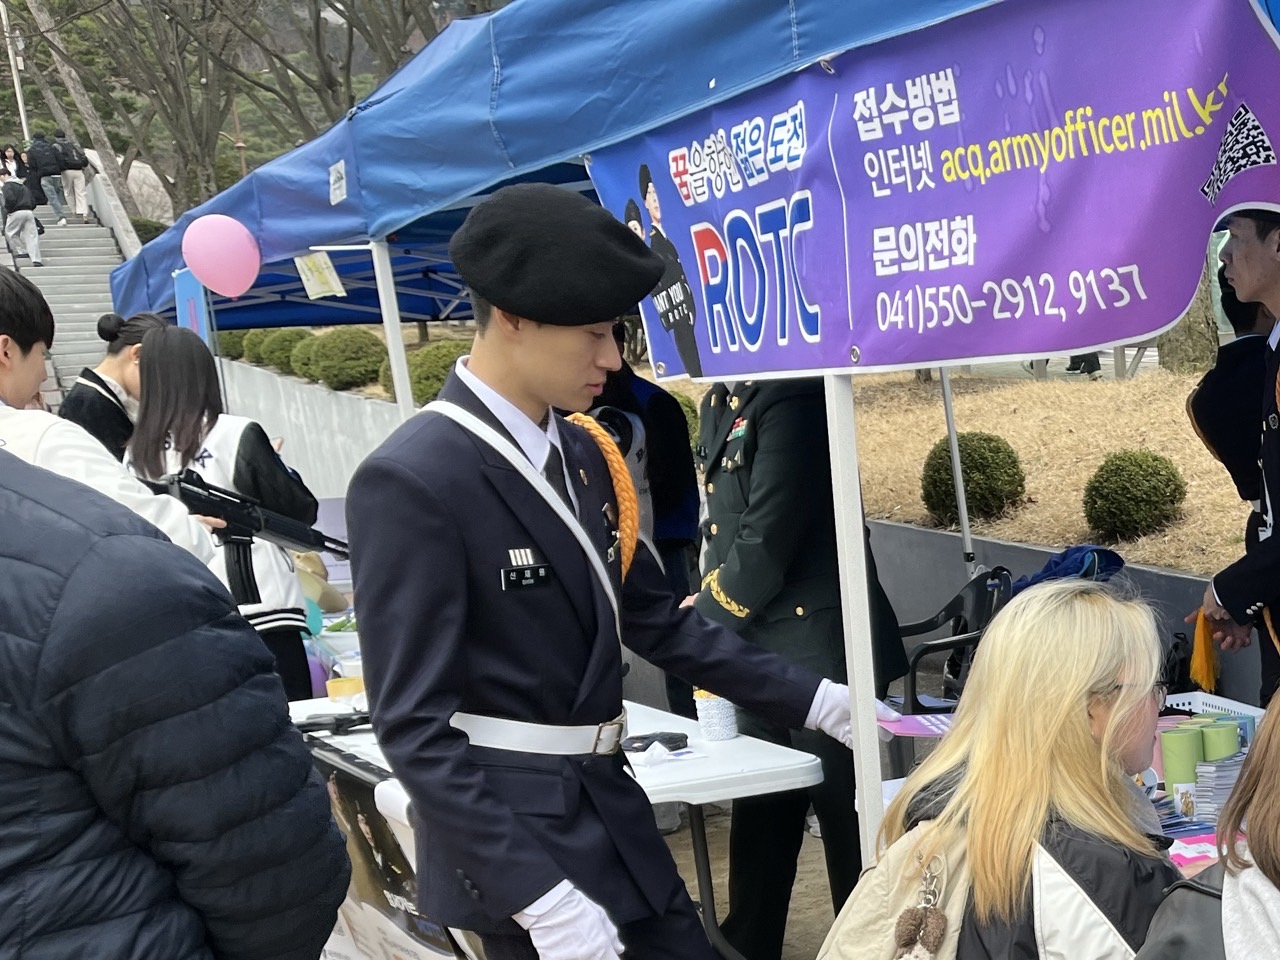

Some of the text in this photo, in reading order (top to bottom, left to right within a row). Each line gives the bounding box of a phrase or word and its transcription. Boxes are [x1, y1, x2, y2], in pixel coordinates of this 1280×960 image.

[767, 101, 807, 171] 도전
[853, 67, 961, 142] 접수방법
[863, 140, 936, 198] 인터넷
[690, 190, 821, 353] ROTC
[872, 214, 977, 277] 문의전화
[875, 264, 1148, 334] 041)550-2912, 9137
